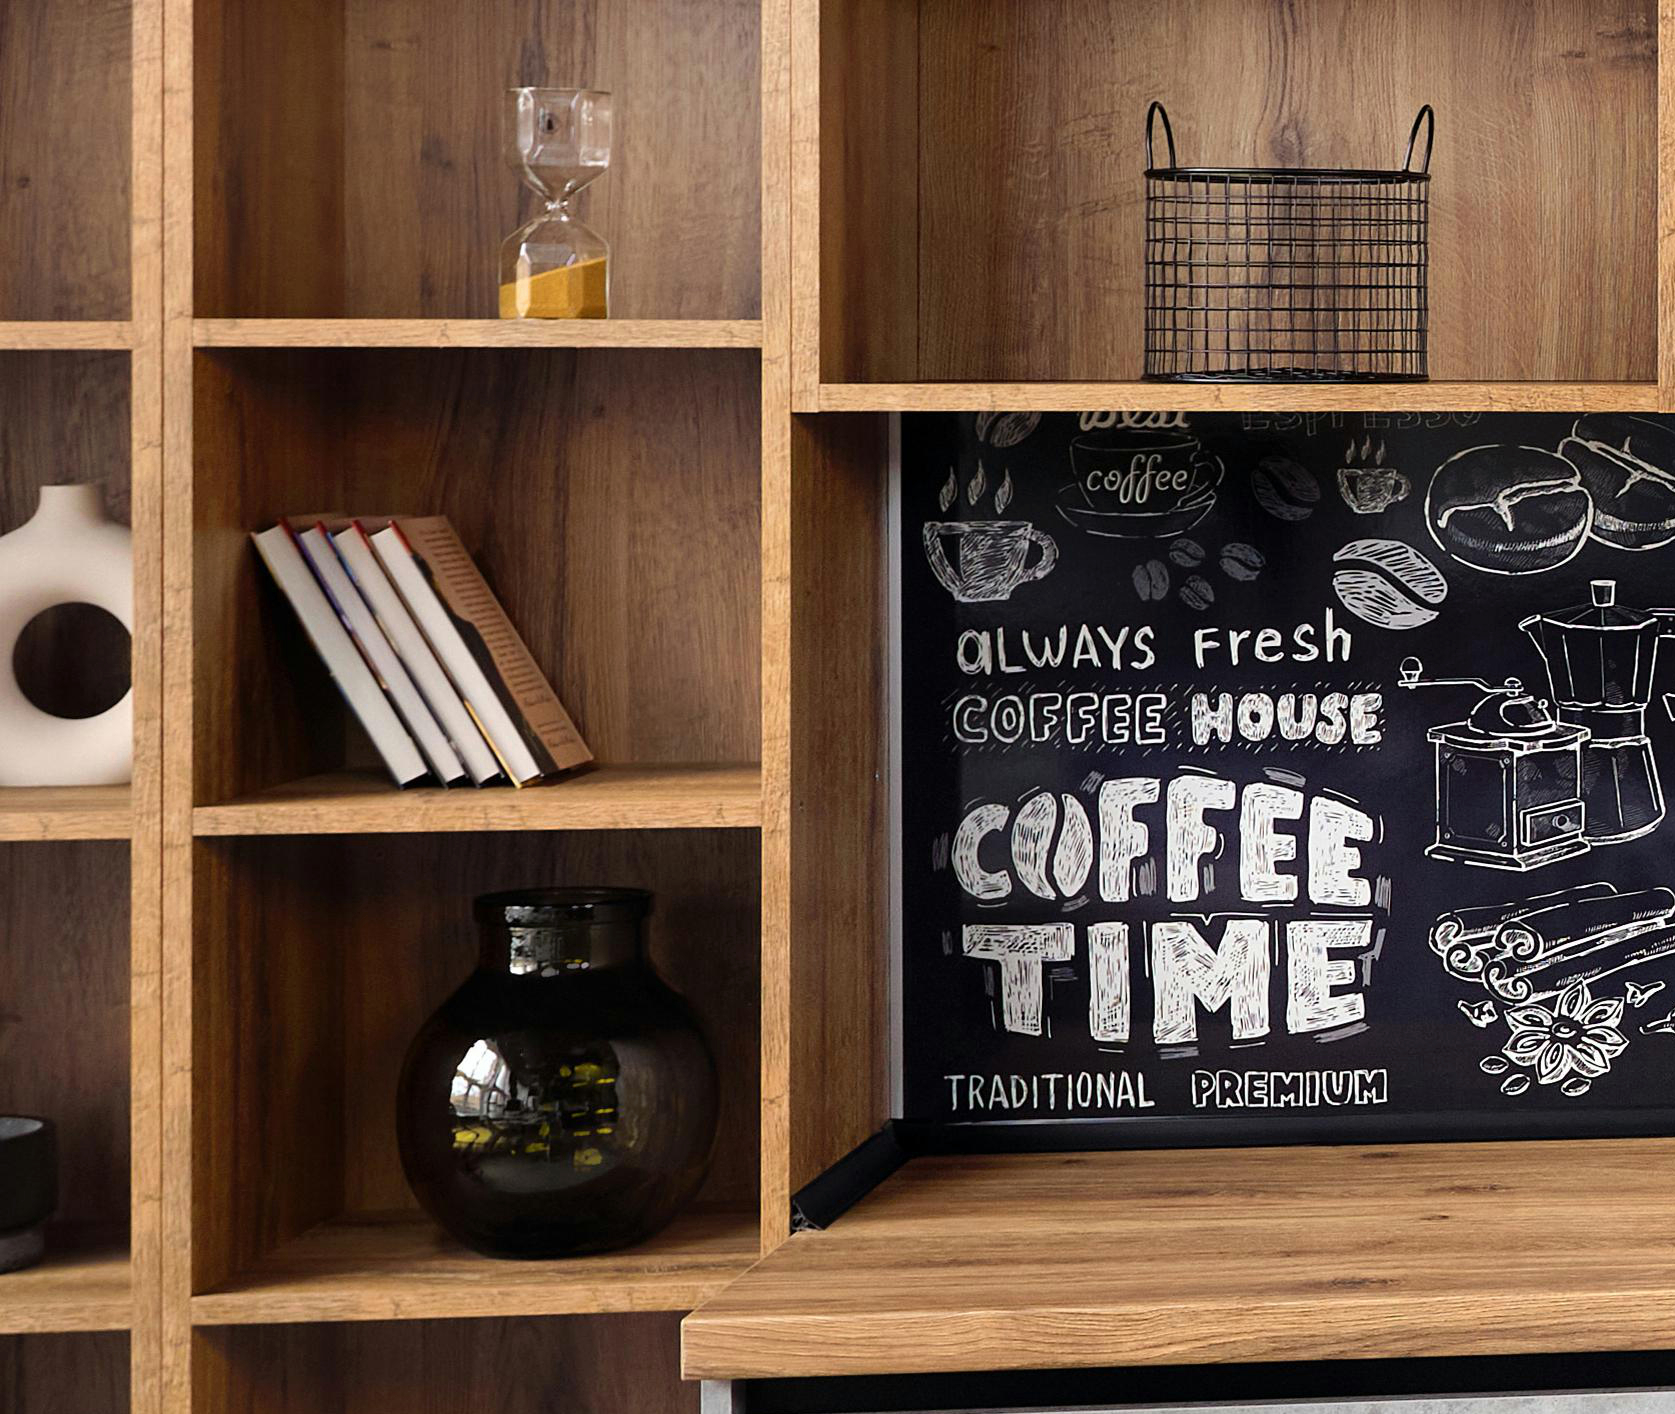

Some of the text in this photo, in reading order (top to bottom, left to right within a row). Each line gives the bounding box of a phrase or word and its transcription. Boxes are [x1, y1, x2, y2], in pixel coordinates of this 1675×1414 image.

[1086, 454, 1188, 503] coffee
[954, 693, 1382, 745] COFFEE HOUSE
[951, 776, 1373, 906] COFFEE
[962, 920, 1373, 1043] TIME
[945, 1070, 1387, 1110] TRADITIONAL PREMIUM
